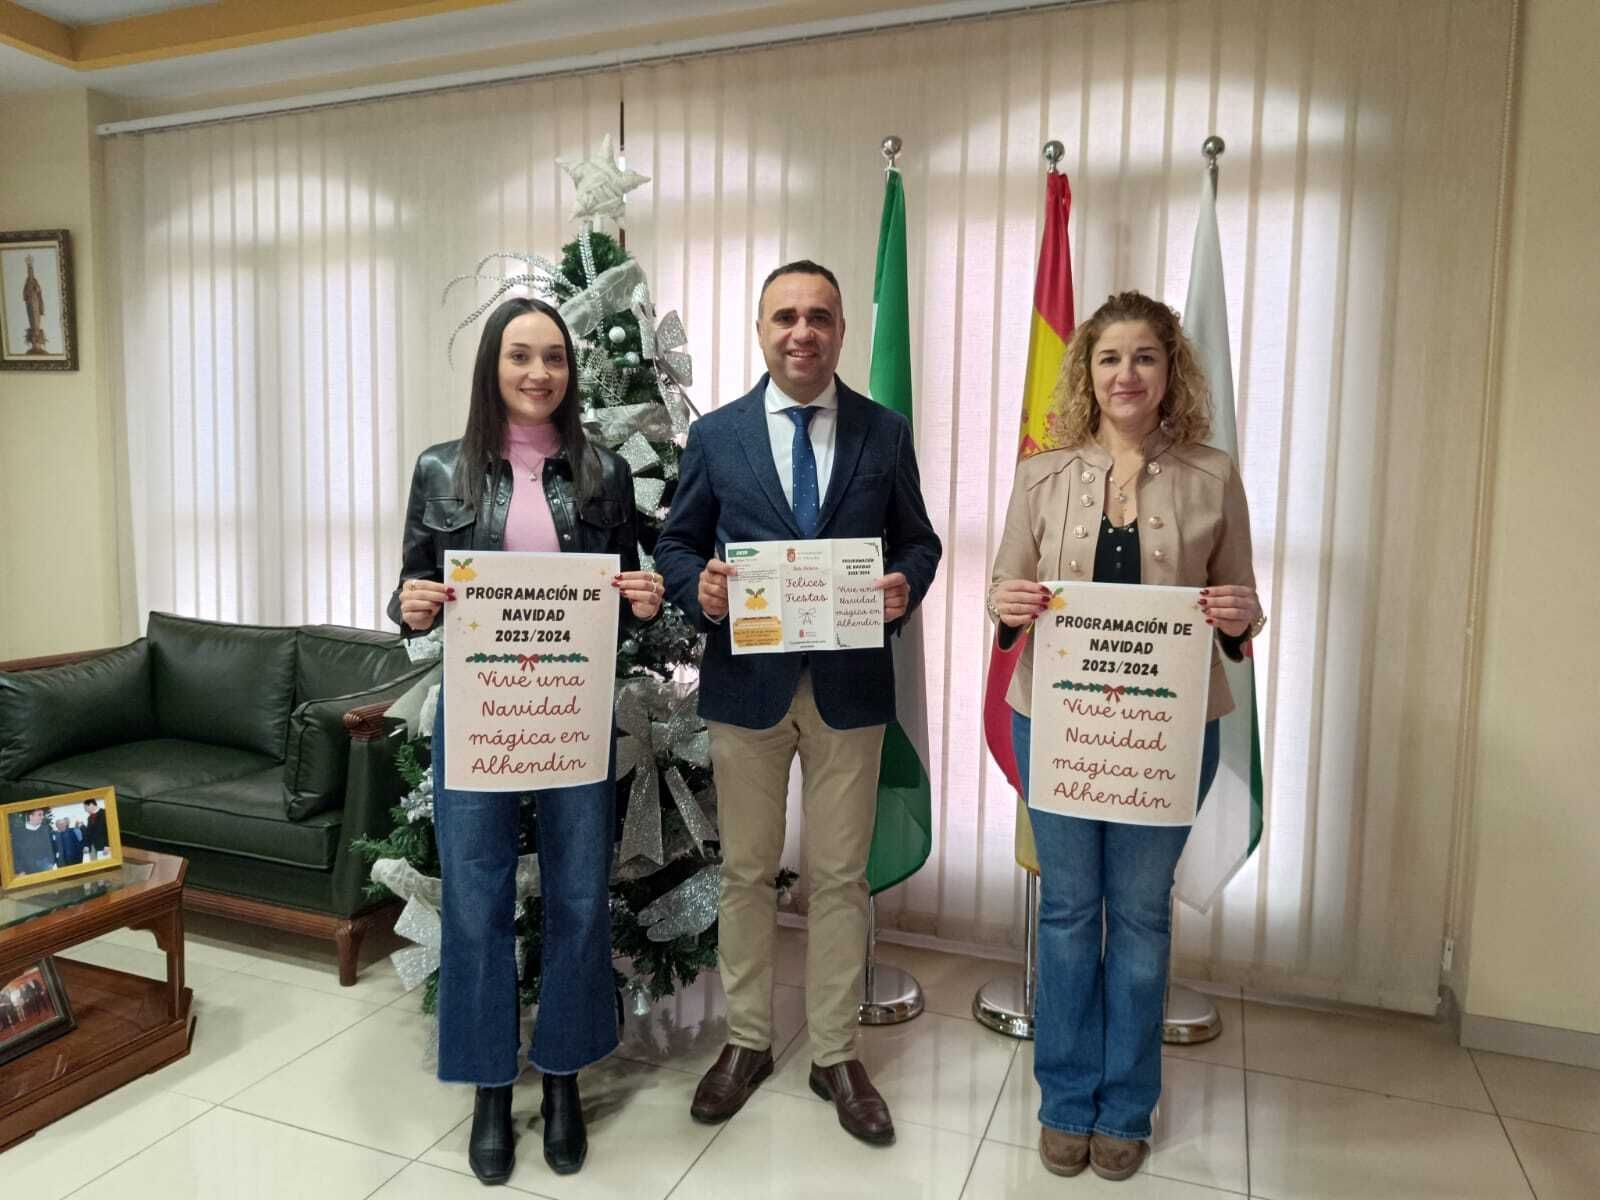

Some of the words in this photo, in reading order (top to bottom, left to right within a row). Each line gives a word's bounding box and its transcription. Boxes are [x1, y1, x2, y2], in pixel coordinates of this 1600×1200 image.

[466, 585, 578, 601] PROGRAMACIÓN
[583, 589, 601, 601] DE
[502, 608, 566, 622] NAVIDAD
[1055, 615, 1169, 636] PROGRAMACIÓN
[1173, 622, 1193, 636] DE
[495, 629, 571, 643] 2023/2024
[1089, 638, 1154, 655] NAVIDAD
[1081, 658, 1159, 677] 2023/2024
[477, 671, 532, 688] Vive
[536, 674, 586, 687] una
[481, 695, 582, 717] Navidad
[1063, 698, 1117, 719] Vive
[1120, 706, 1173, 724] una
[468, 728, 557, 752] mágica
[560, 729, 591, 744] en
[1065, 727, 1168, 752] Navidad
[471, 752, 587, 775] Alhendín
[1051, 756, 1139, 781] mágica
[1143, 766, 1177, 782] en
[1053, 781, 1173, 809] Alhendín
